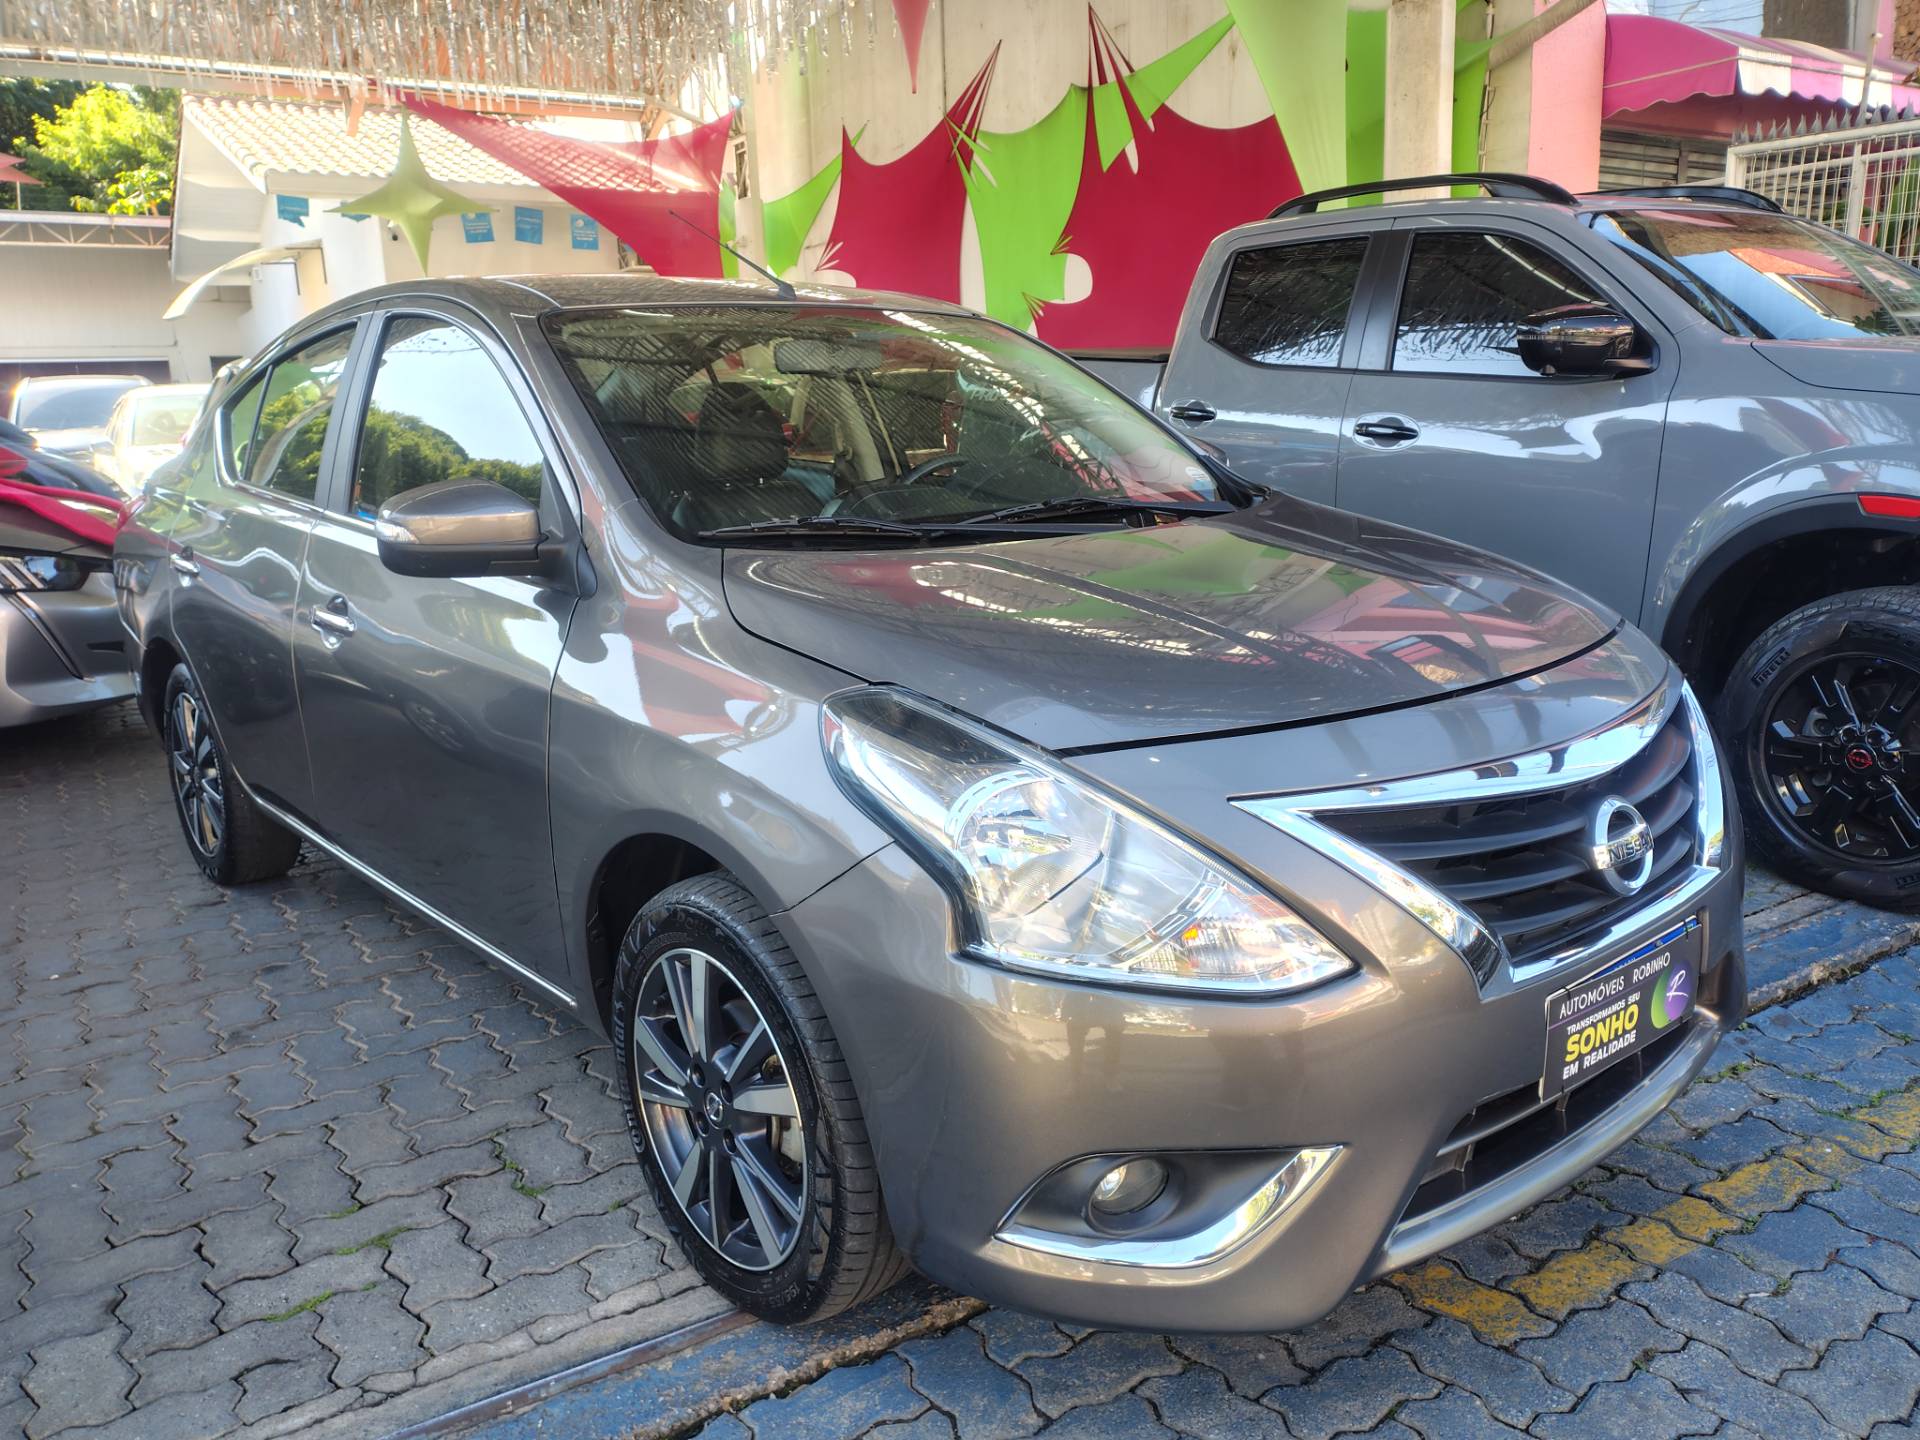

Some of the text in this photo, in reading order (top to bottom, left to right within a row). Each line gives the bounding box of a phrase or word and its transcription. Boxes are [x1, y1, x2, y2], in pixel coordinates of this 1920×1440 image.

[1559, 952, 1671, 1019] AUTOMÓVEIS ROBINHO
[1567, 991, 1641, 1034] TRANSFORMAMOS SEU
[1563, 1030, 1637, 1080] EM REALIDADE
[1564, 1004, 1639, 1063] SONHO
